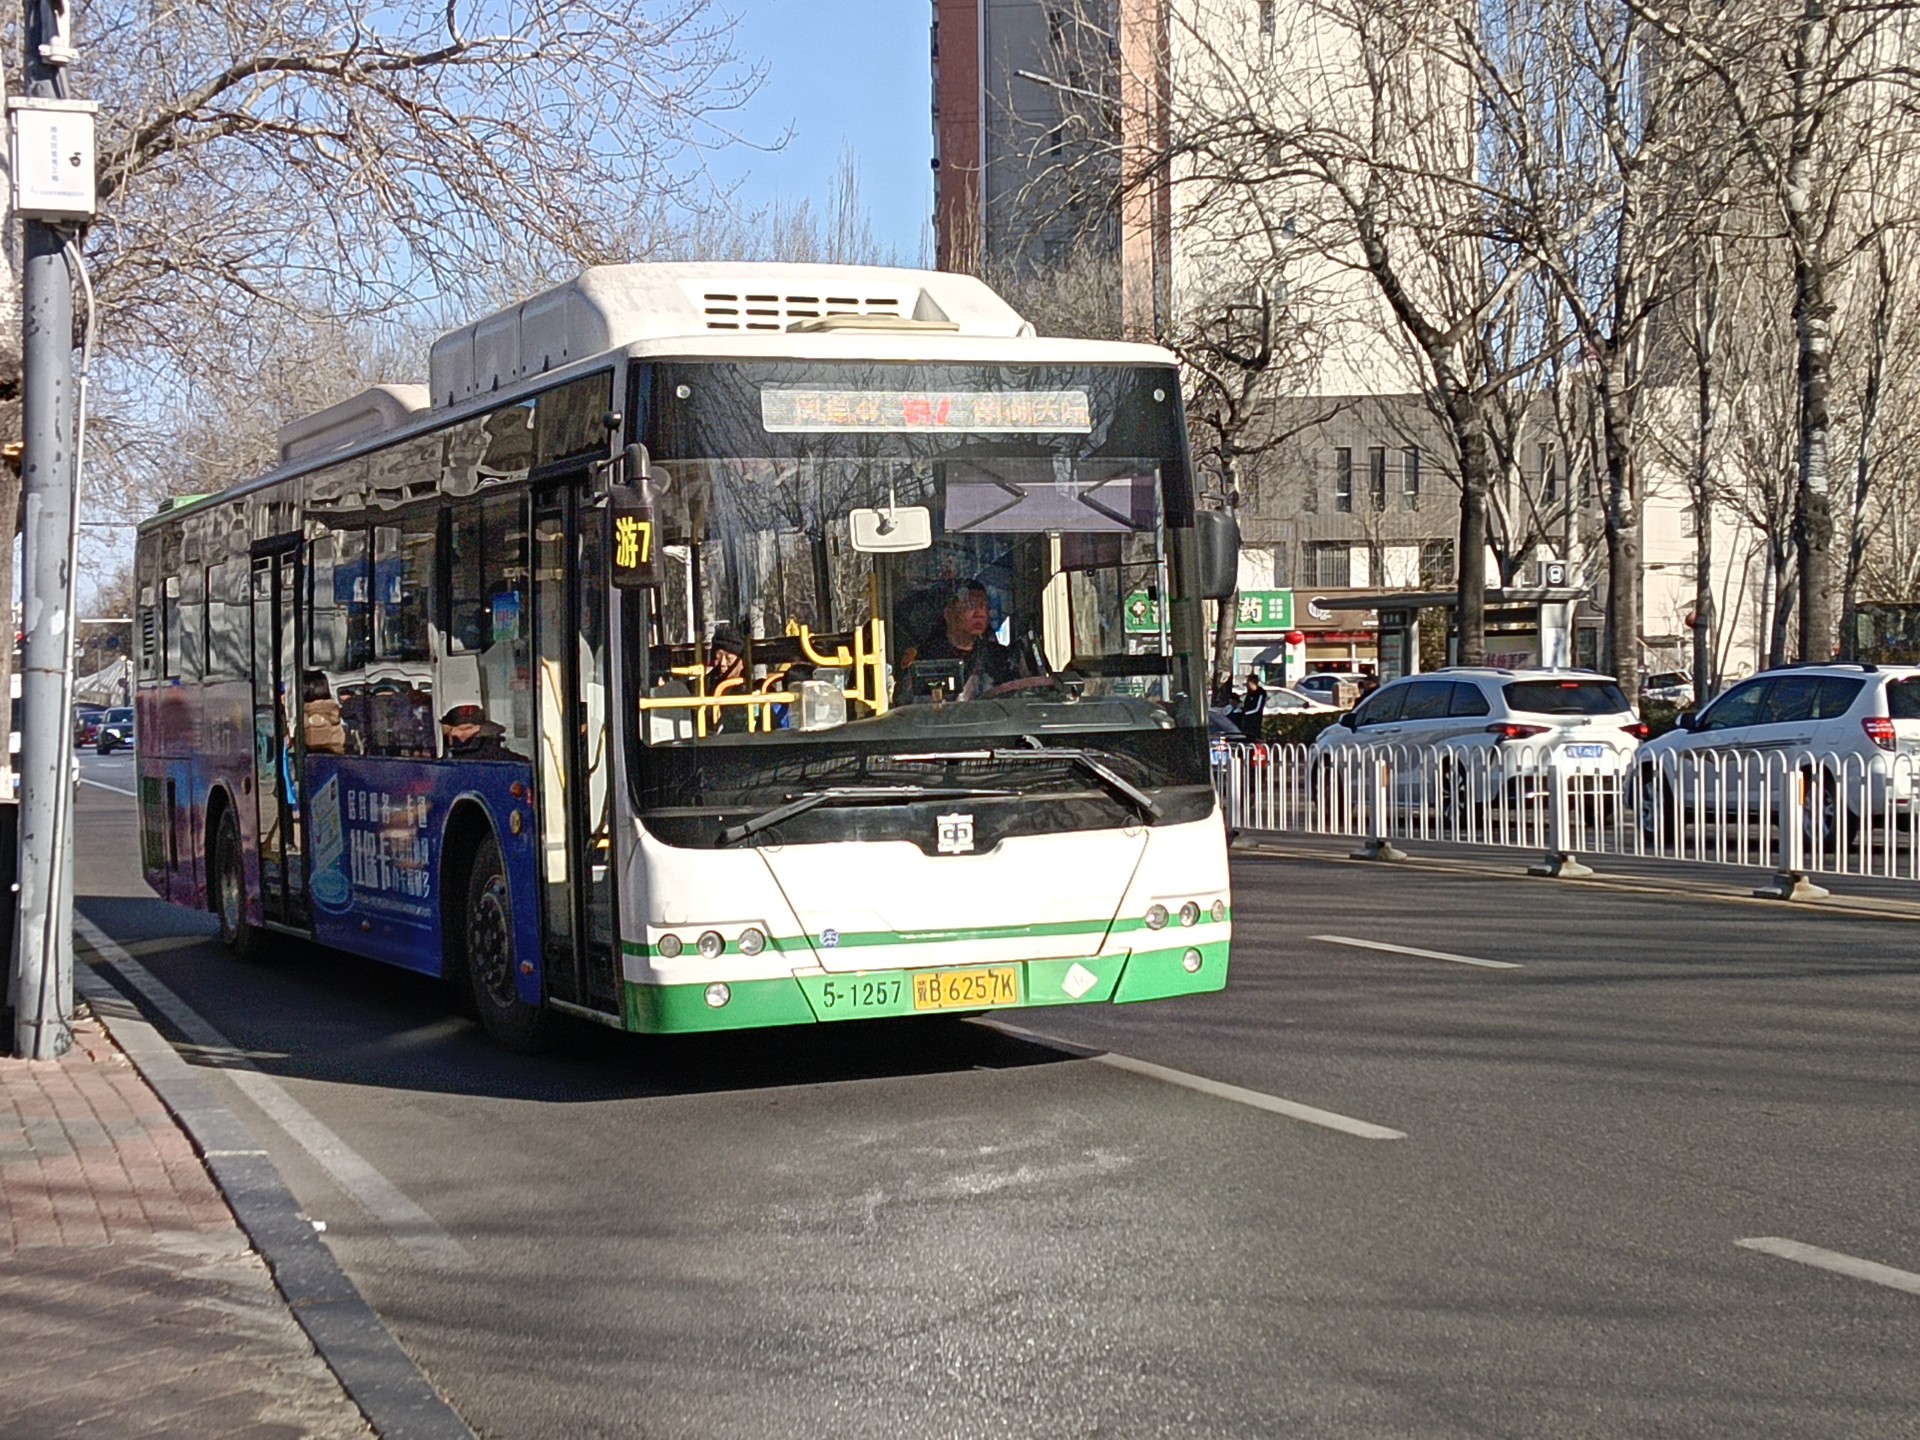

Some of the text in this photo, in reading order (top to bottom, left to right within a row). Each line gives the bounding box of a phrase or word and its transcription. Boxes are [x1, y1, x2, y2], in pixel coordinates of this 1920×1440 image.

[616, 516, 650, 568] 游7
[350, 828, 391, 890] 社保卡
[823, 981, 900, 1007] 5-1257
